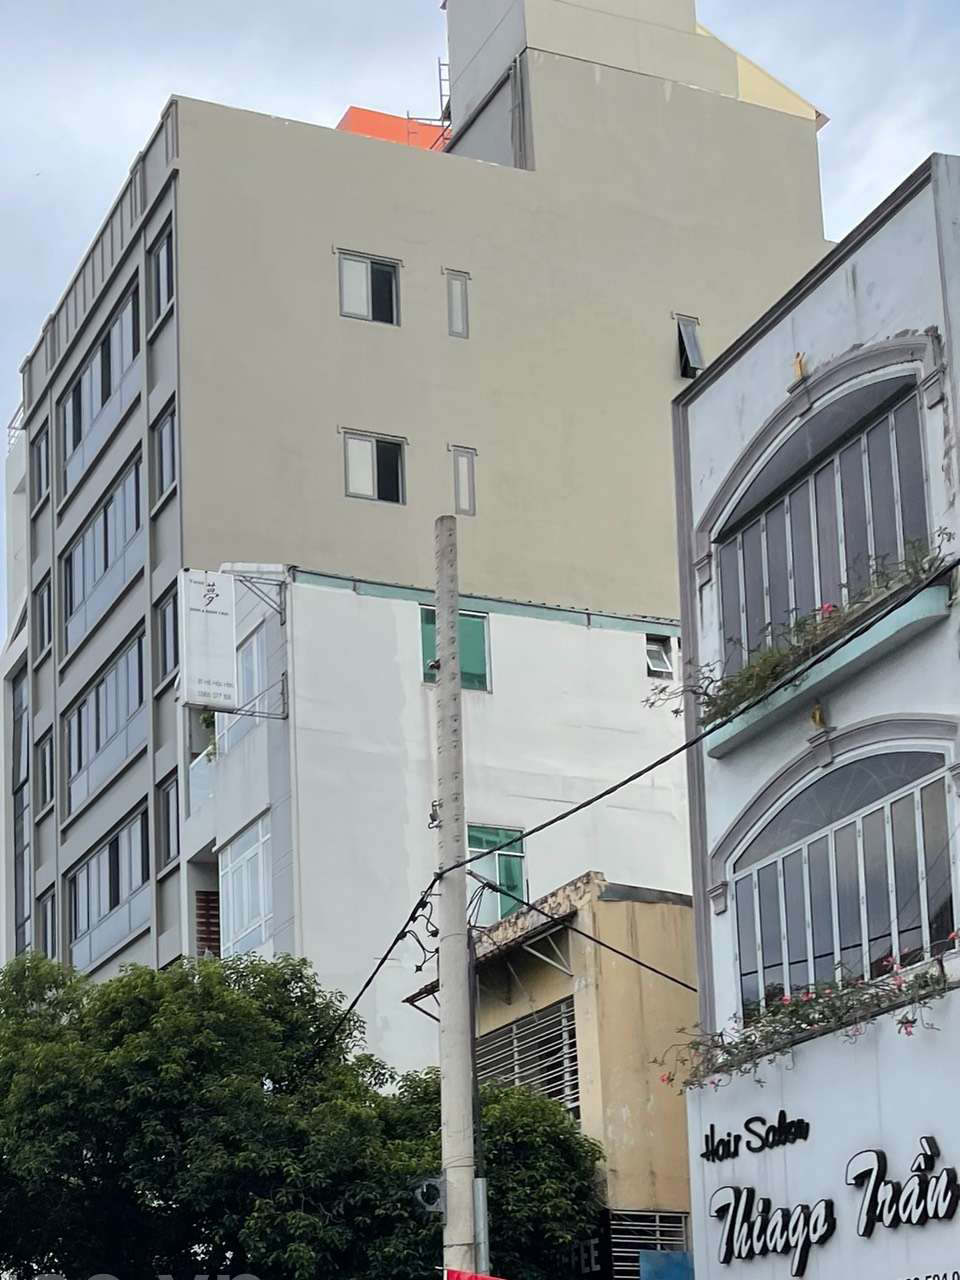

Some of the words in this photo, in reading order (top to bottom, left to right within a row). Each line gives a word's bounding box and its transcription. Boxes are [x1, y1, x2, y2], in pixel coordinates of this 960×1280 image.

[700, 1123, 742, 1163] Hair
[744, 1109, 810, 1153] Salon
[709, 1185, 837, 1277] Thiago
[845, 1135, 960, 1238] Trần
